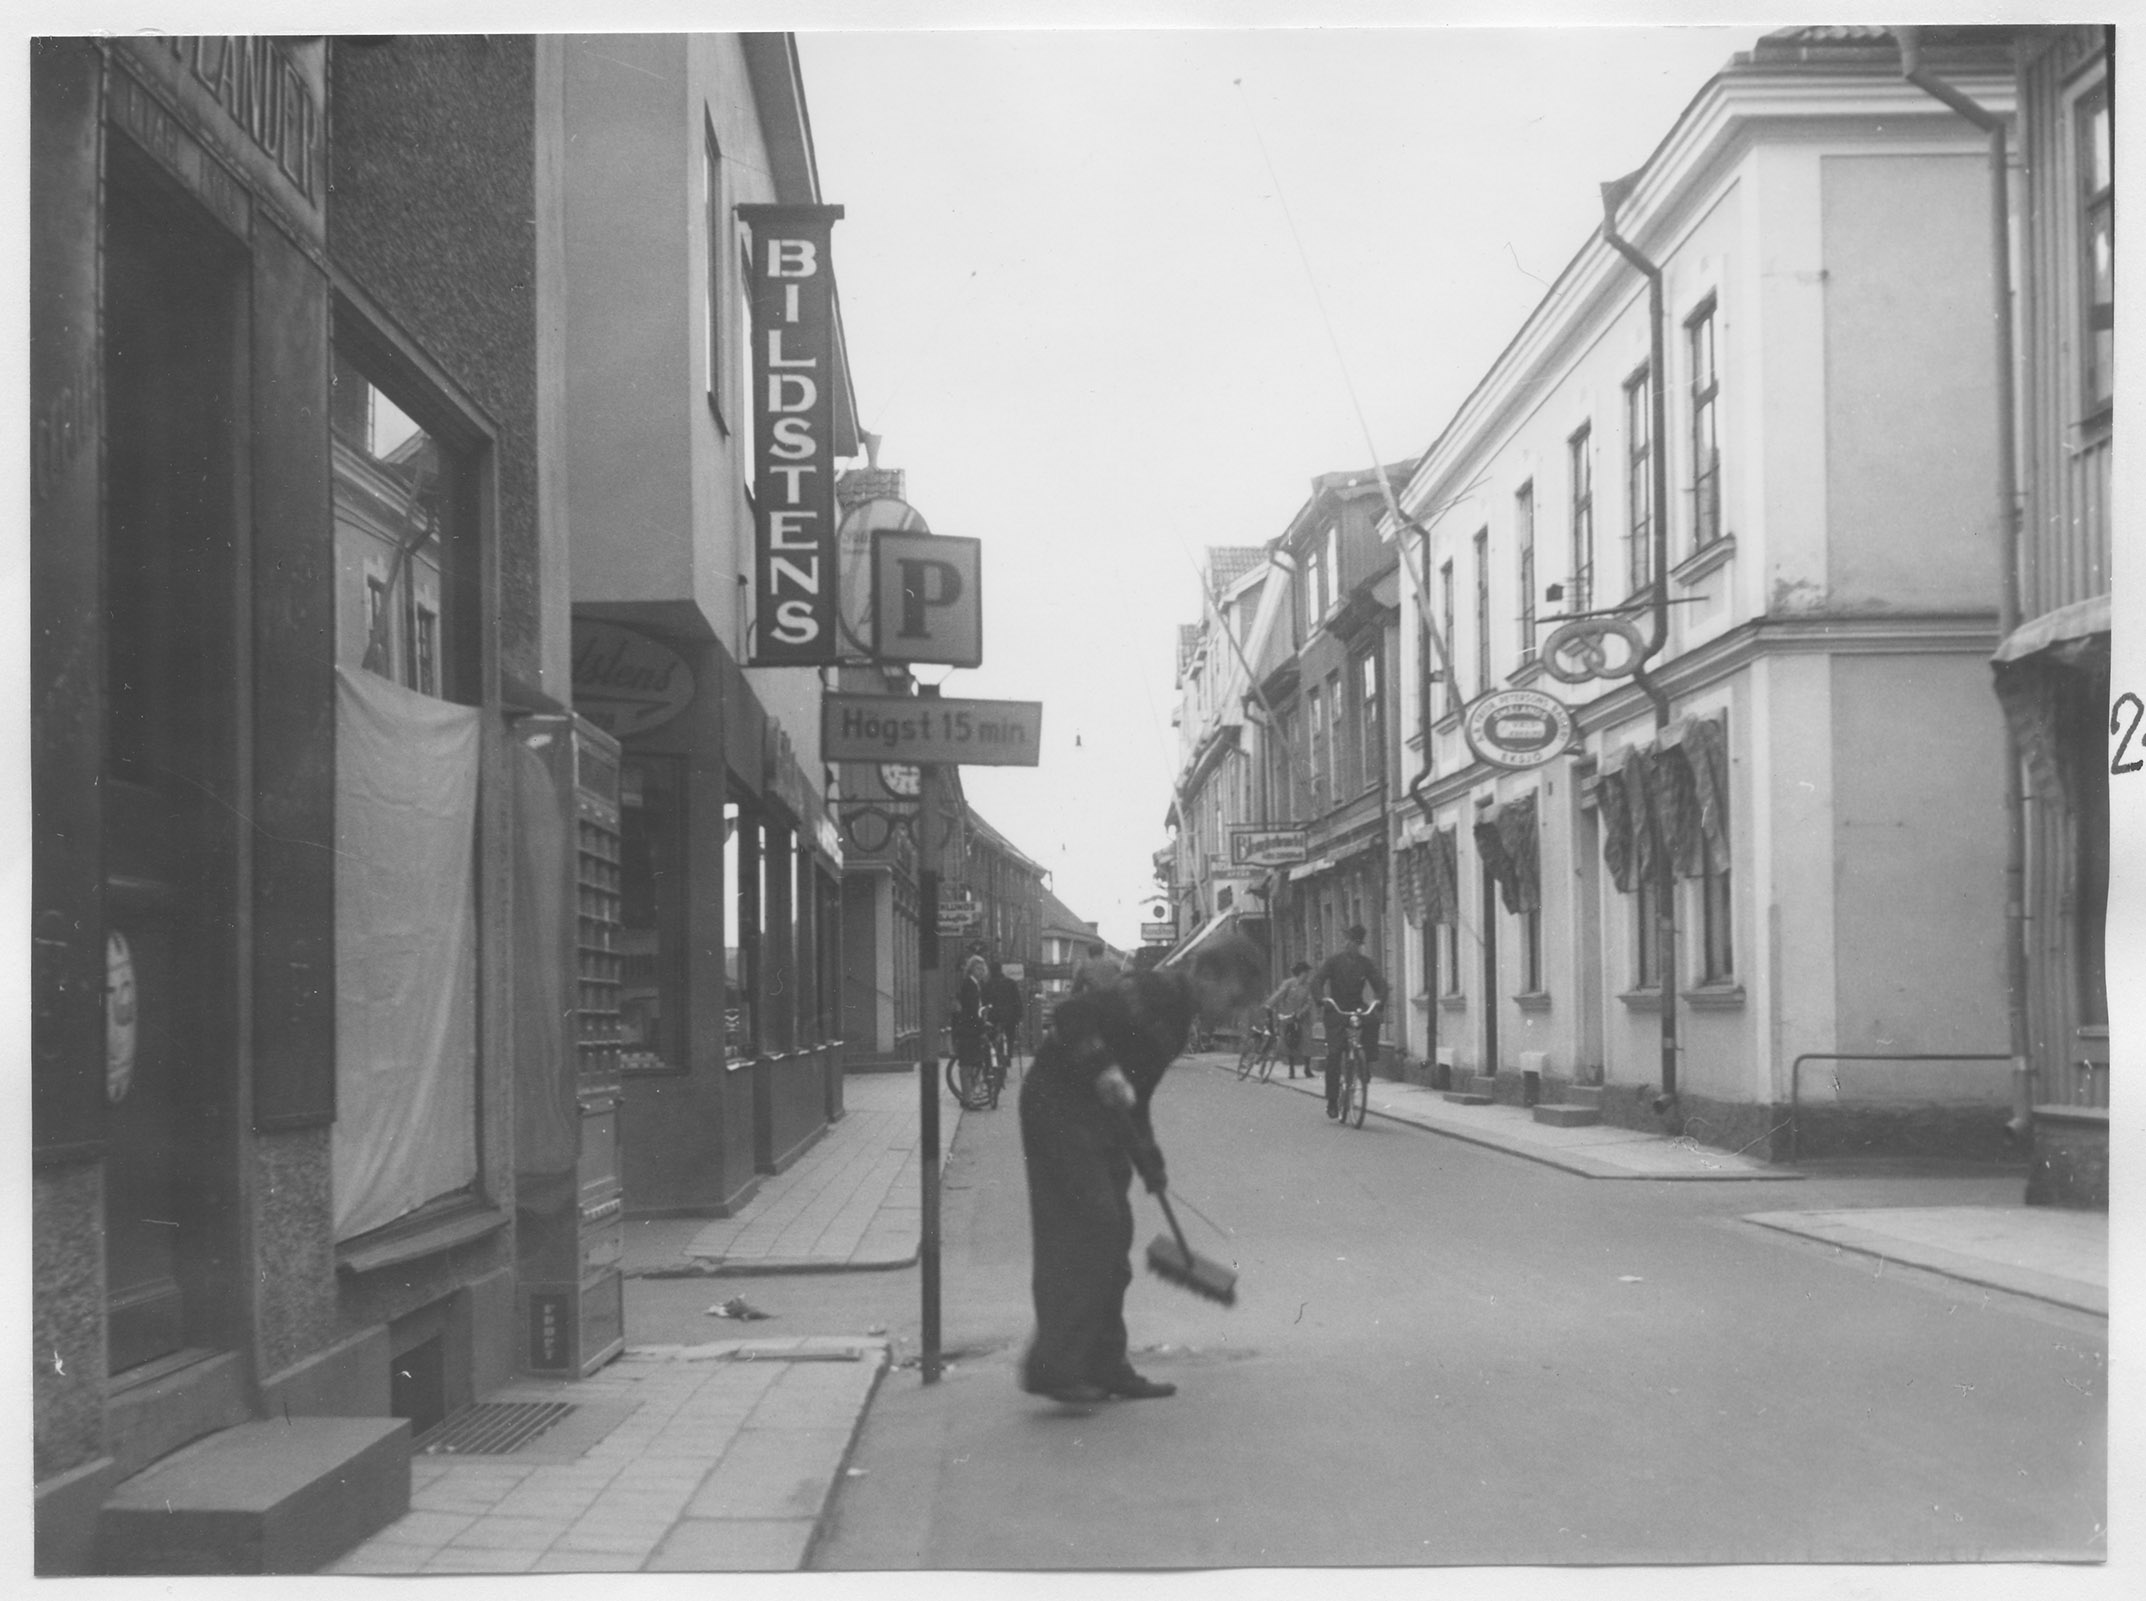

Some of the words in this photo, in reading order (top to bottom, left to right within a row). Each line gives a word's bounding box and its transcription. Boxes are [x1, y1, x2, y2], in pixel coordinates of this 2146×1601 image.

[766, 239, 820, 645] BILDSTENS
[896, 557, 964, 640] P
[841, 707, 931, 747] Högst
[941, 710, 973, 743] 15
[978, 716, 1027, 745] min
